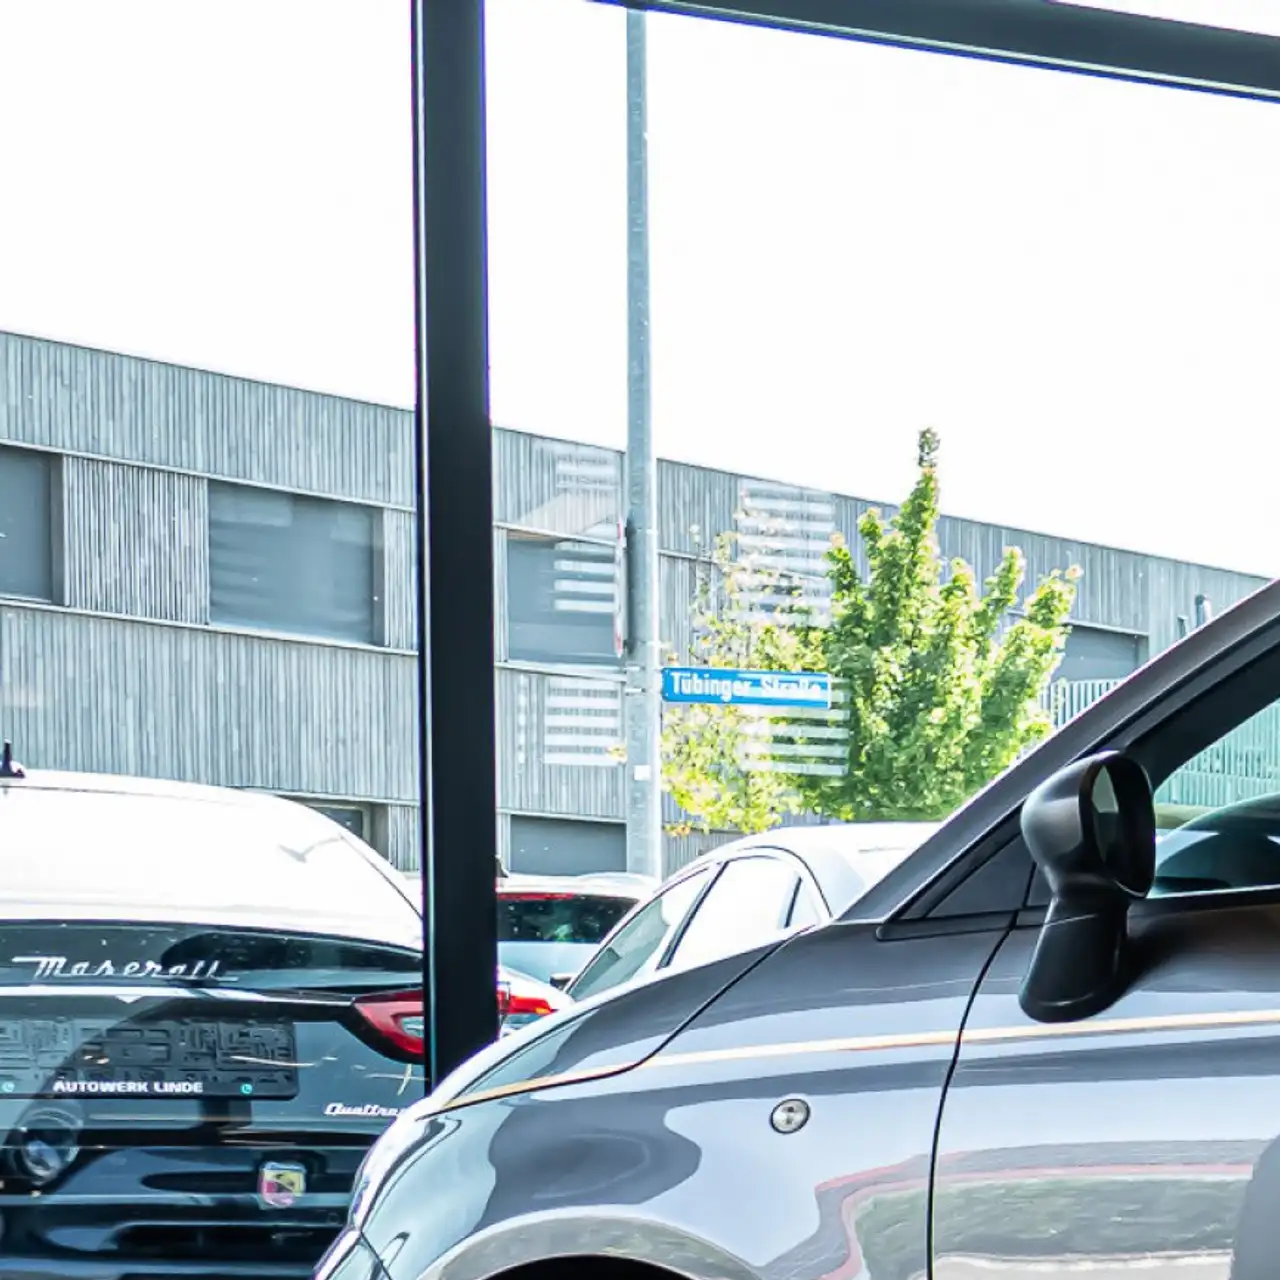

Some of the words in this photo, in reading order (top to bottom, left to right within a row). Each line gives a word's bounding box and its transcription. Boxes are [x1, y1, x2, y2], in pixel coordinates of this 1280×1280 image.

[670, 671, 753, 702] Tübinger
[52, 1080, 149, 1093] AUTOWERK
[153, 1080, 204, 1093] LINDE
